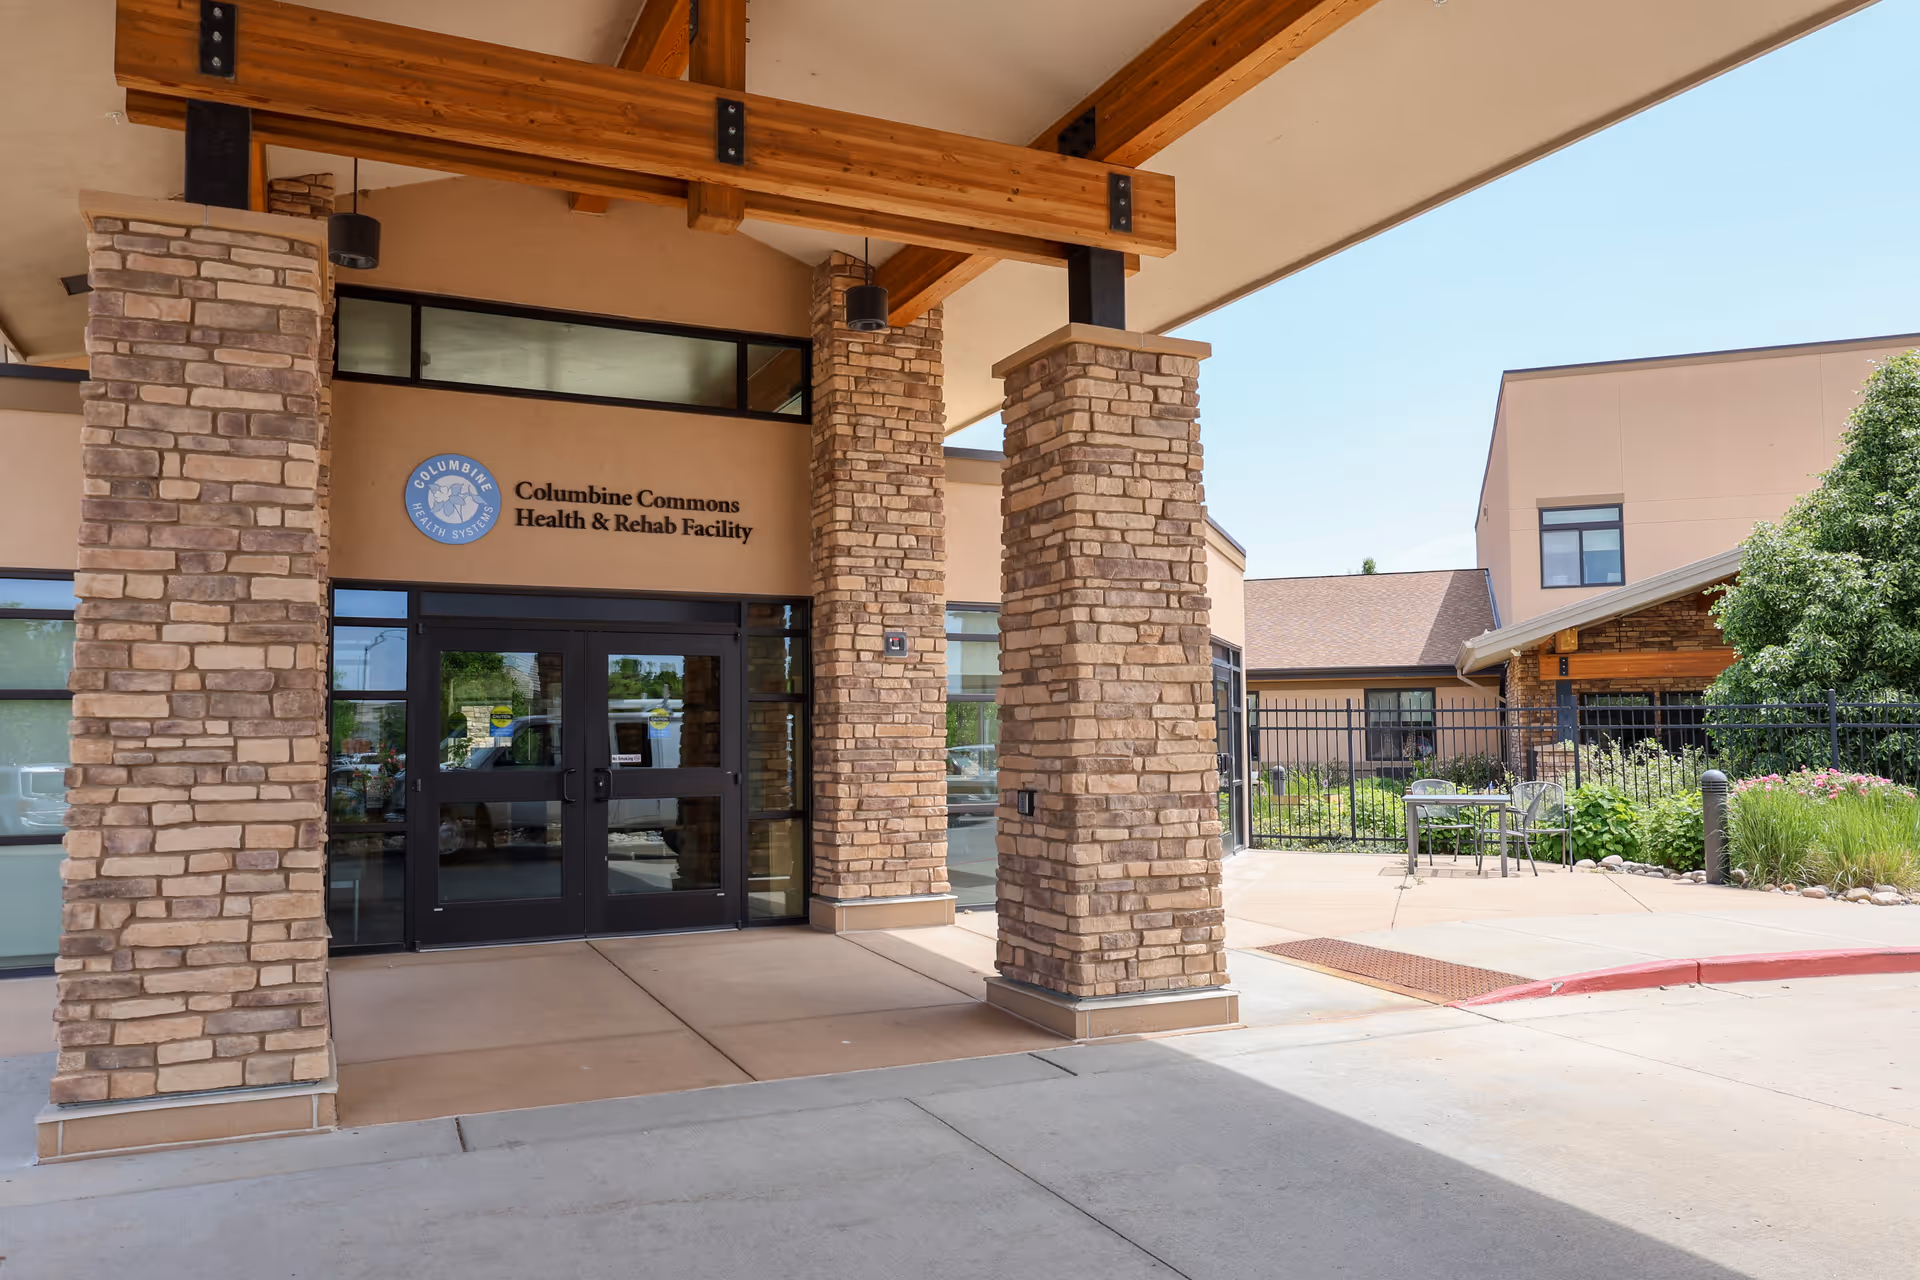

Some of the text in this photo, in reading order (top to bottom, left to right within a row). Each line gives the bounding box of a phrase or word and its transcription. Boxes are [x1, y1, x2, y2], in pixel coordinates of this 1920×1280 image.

[414, 460, 492, 492] COLUMBINE
[515, 481, 740, 514] Columbine Commons
[412, 502, 493, 539] HEALTH SYSTEMS
[514, 507, 753, 545] Health & Rehab Facility
